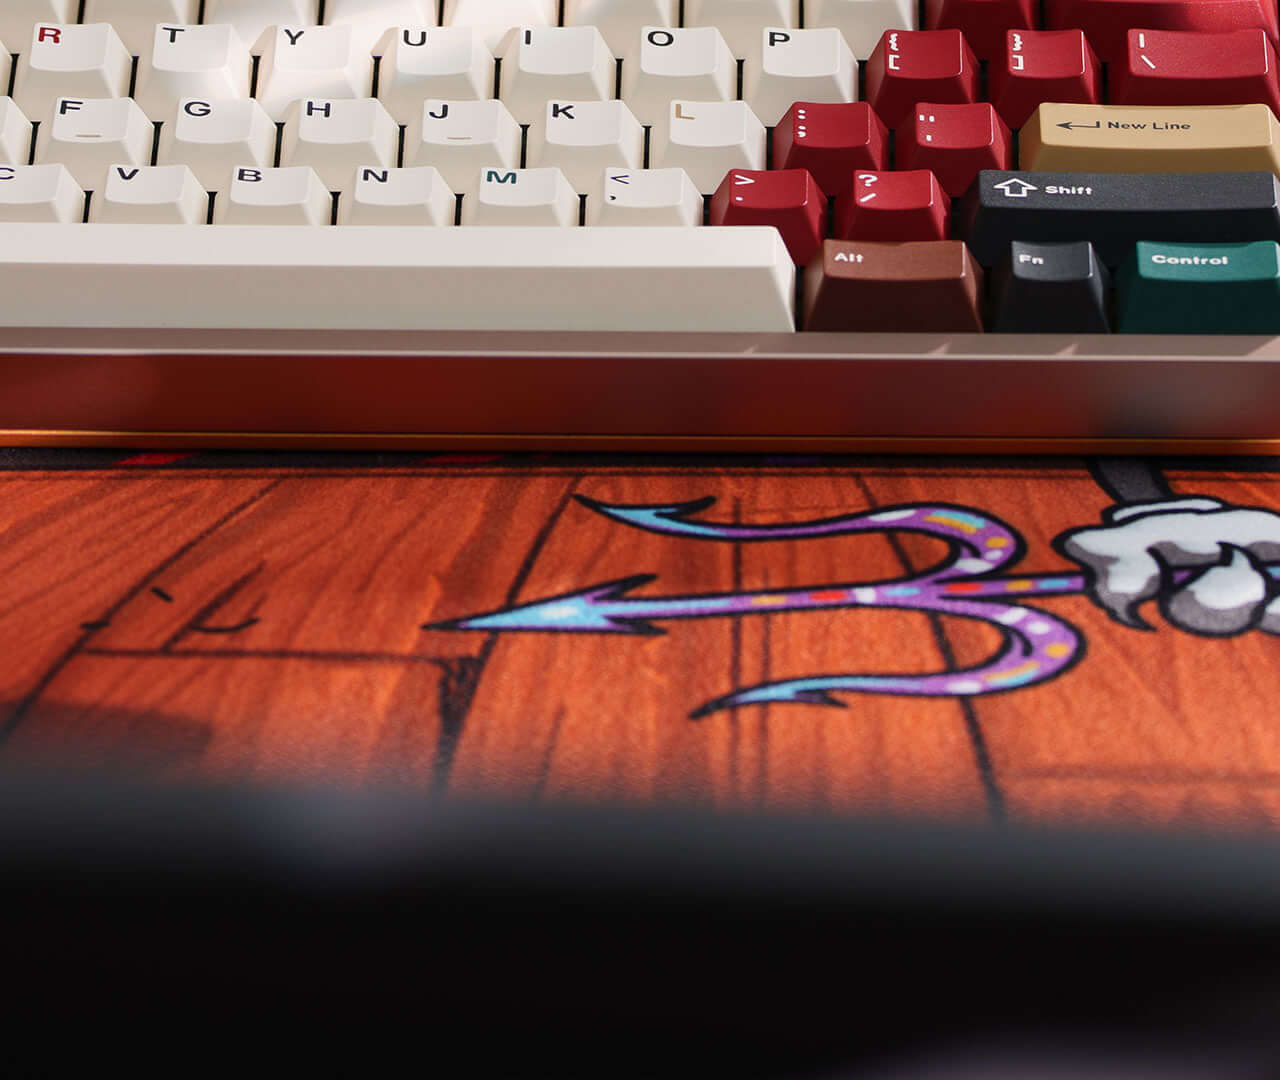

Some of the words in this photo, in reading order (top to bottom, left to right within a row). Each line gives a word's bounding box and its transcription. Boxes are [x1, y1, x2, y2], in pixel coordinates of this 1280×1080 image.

[38, 26, 62, 44] R
[162, 26, 185, 44] T
[284, 28, 305, 46] Y
[403, 29, 427, 47] U
[524, 29, 532, 46] I
[647, 30, 674, 47] O
[768, 31, 791, 47] P
[59, 99, 84, 115] F
[183, 101, 212, 117] G
[306, 100, 331, 118] H
[428, 104, 449, 120] J
[552, 103, 575, 120] K
[675, 103, 696, 121] L
[1107, 121, 1147, 130] New
[1152, 122, 1191, 130] Line
[116, 167, 140, 181] V
[237, 168, 262, 183] B
[362, 168, 389, 183] N
[486, 170, 517, 185] M
[1045, 185, 1093, 195] Shift
[834, 252, 864, 263] Alt
[1018, 253, 1044, 265] Fn
[1151, 254, 1228, 265] Control
